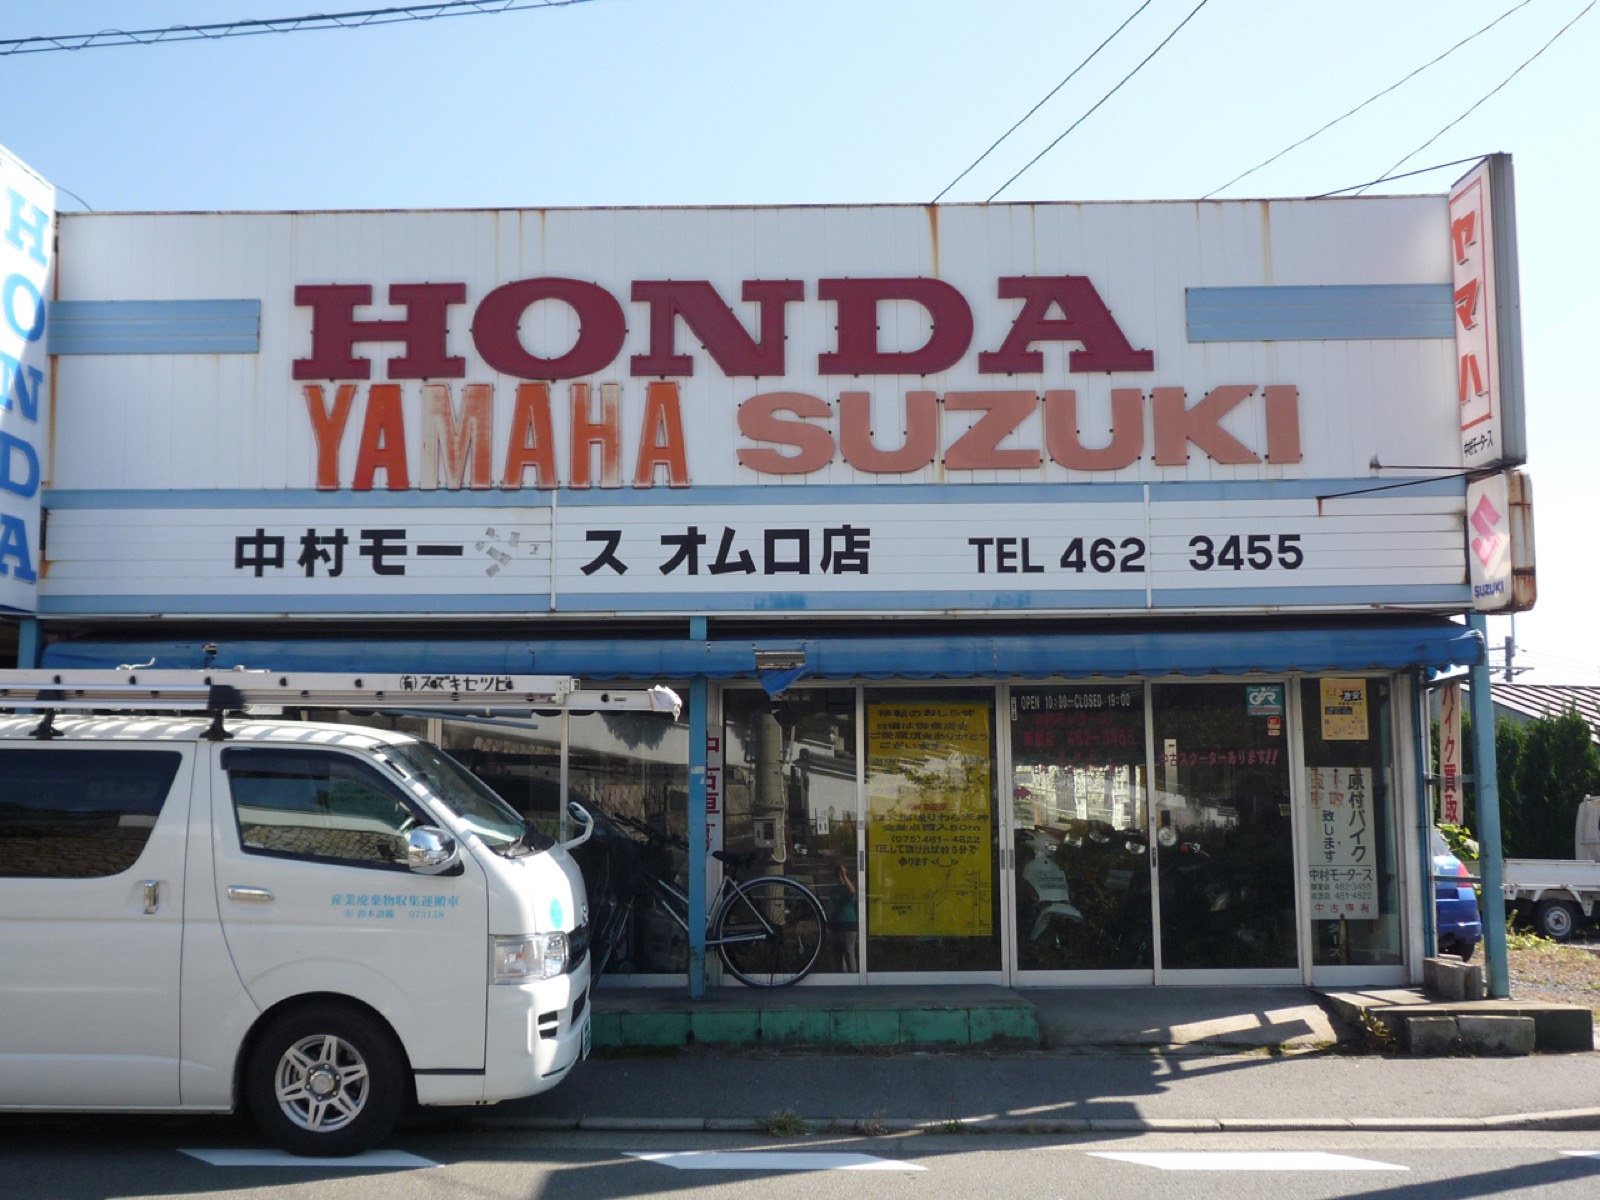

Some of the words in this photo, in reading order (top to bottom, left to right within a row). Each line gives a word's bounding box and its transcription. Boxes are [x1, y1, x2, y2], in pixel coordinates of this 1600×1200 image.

[293, 276, 1154, 380] HONDA
[1450, 209, 1488, 405] ヤマハ
[0, 188, 48, 584] HONDA
[304, 381, 691, 492] YAMAHA
[736, 385, 1302, 475] SUZUKI
[968, 537, 1045, 574] TEL
[1060, 537, 1146, 574] 462
[1188, 534, 1304, 572] 3455
[1474, 579, 1505, 599] SUZUKI
[1020, 695, 1040, 710] OPEN
[1321, 809, 1336, 863] 致します
[1347, 774, 1367, 863] 原付バイク
[331, 894, 460, 908] 産業廃棄物収集運搬車
[1309, 868, 1373, 882] 中村モータース
